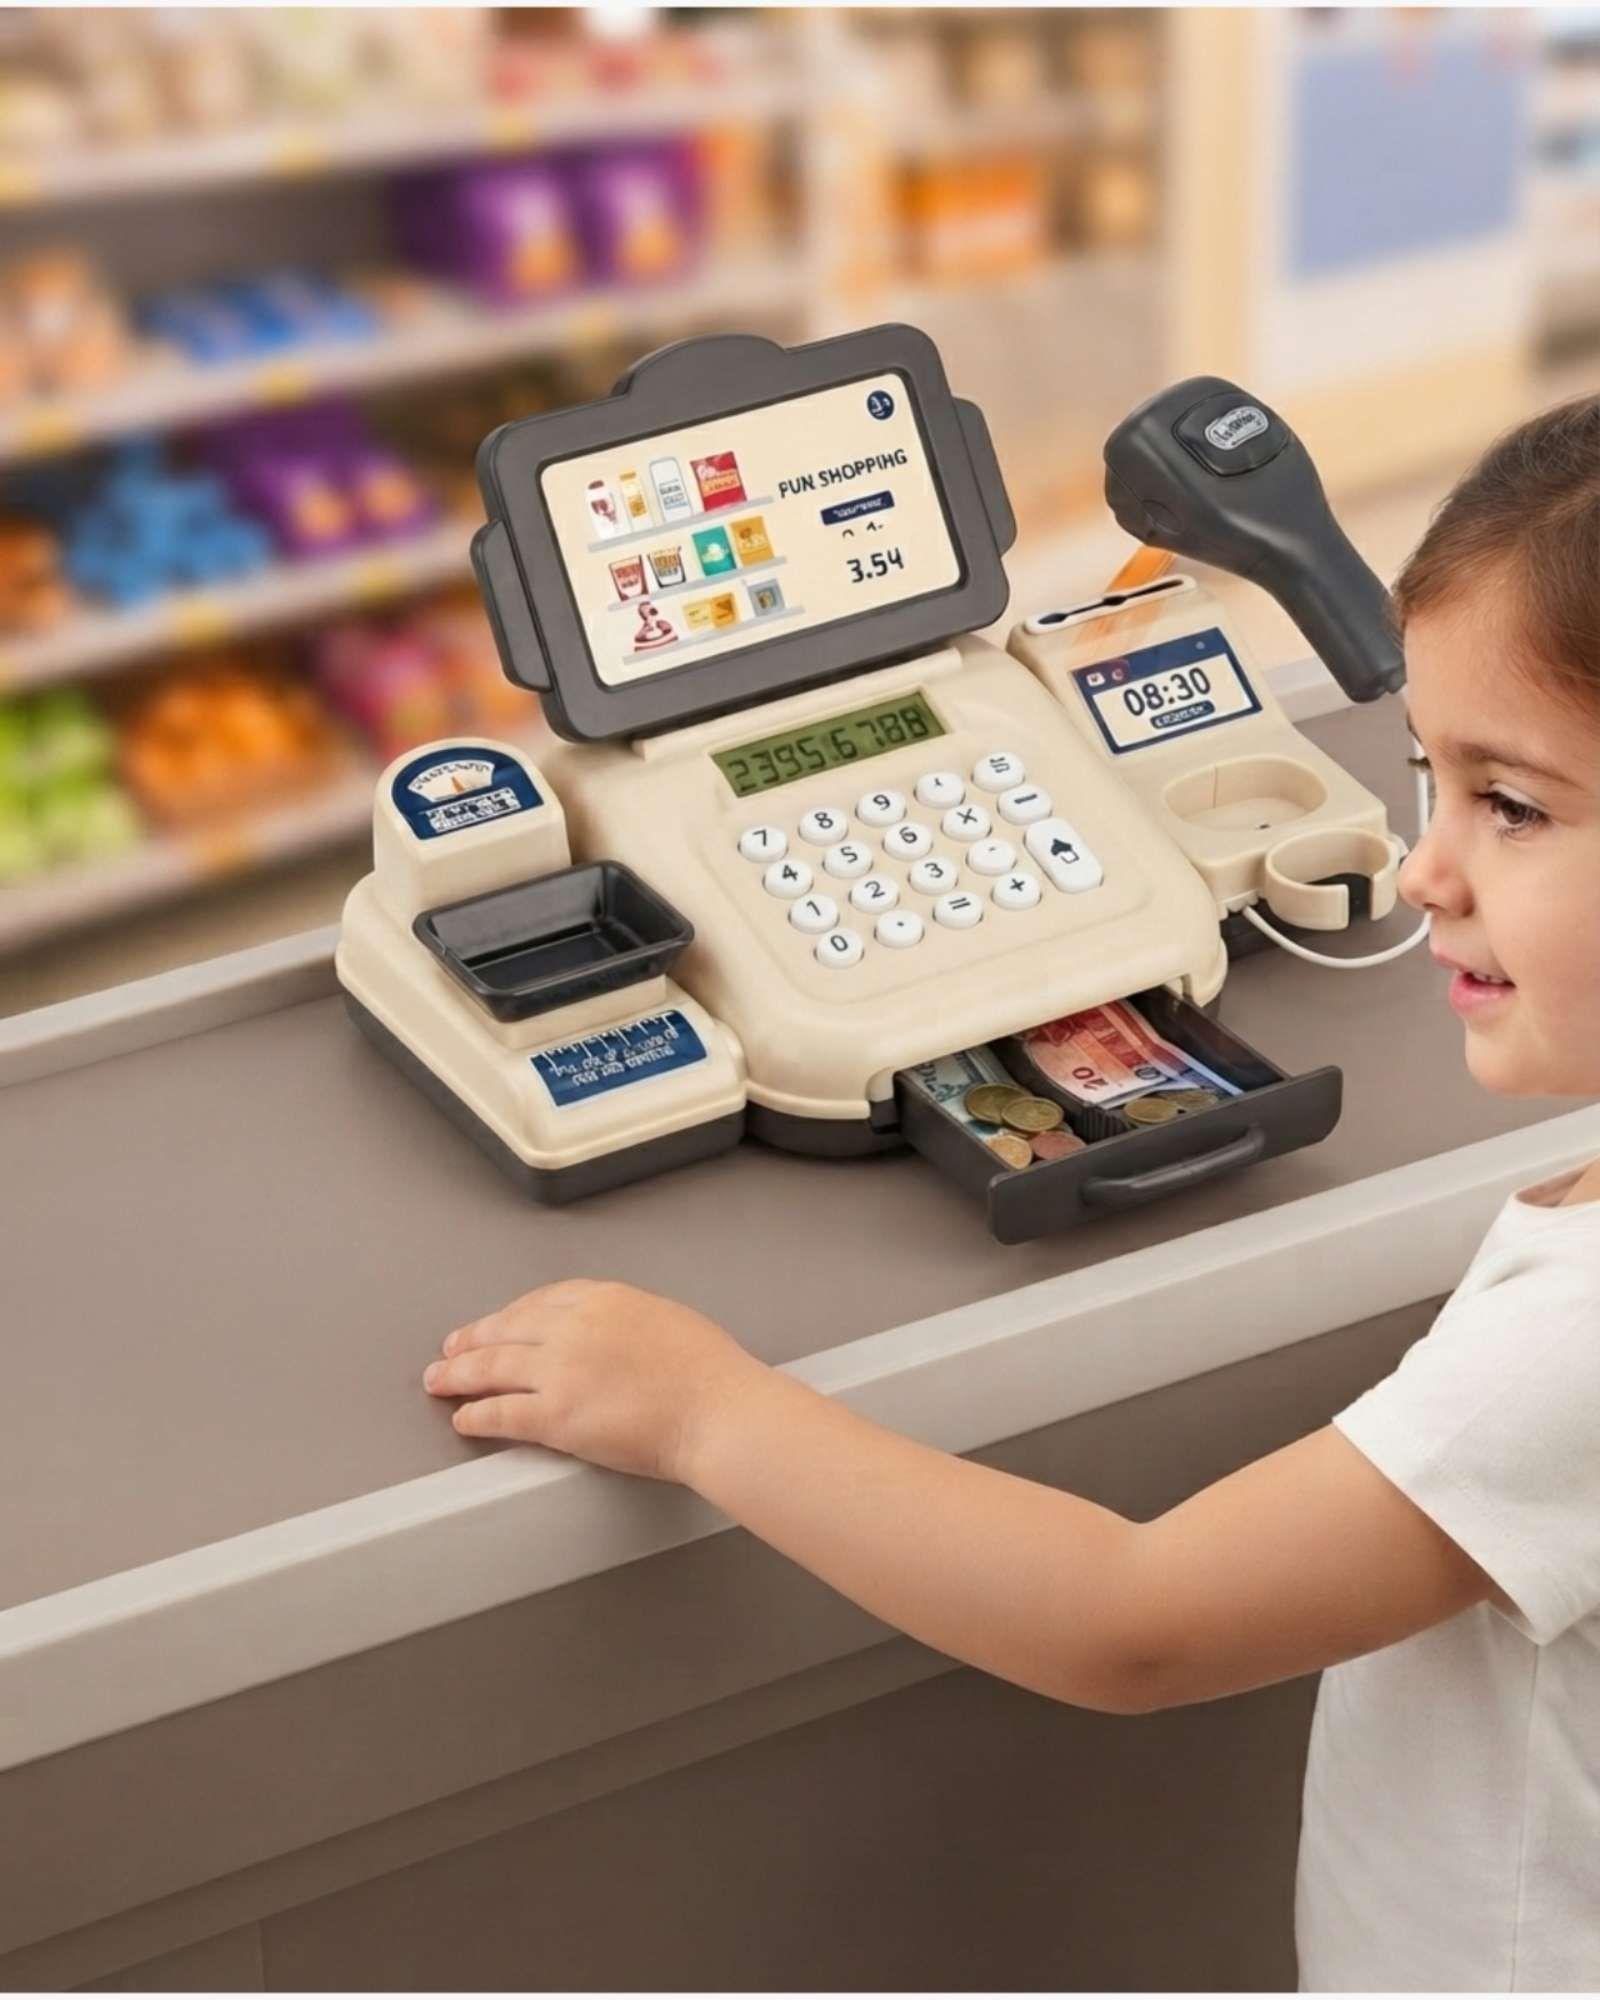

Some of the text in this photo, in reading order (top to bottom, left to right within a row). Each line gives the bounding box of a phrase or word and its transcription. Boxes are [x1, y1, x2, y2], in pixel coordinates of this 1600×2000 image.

[847, 548, 903, 582] 3.54
[1123, 667, 1210, 716] 08:30
[873, 795, 890, 809] 9
[815, 812, 833, 829] 8
[754, 830, 766, 846] 7
[900, 827, 917, 843] 6
[840, 847, 857, 863] 5
[783, 865, 797, 880] 4
[925, 863, 943, 878] 3
[866, 881, 885, 898] 2
[807, 901, 820, 916] 1
[831, 935, 848, 951] 0
